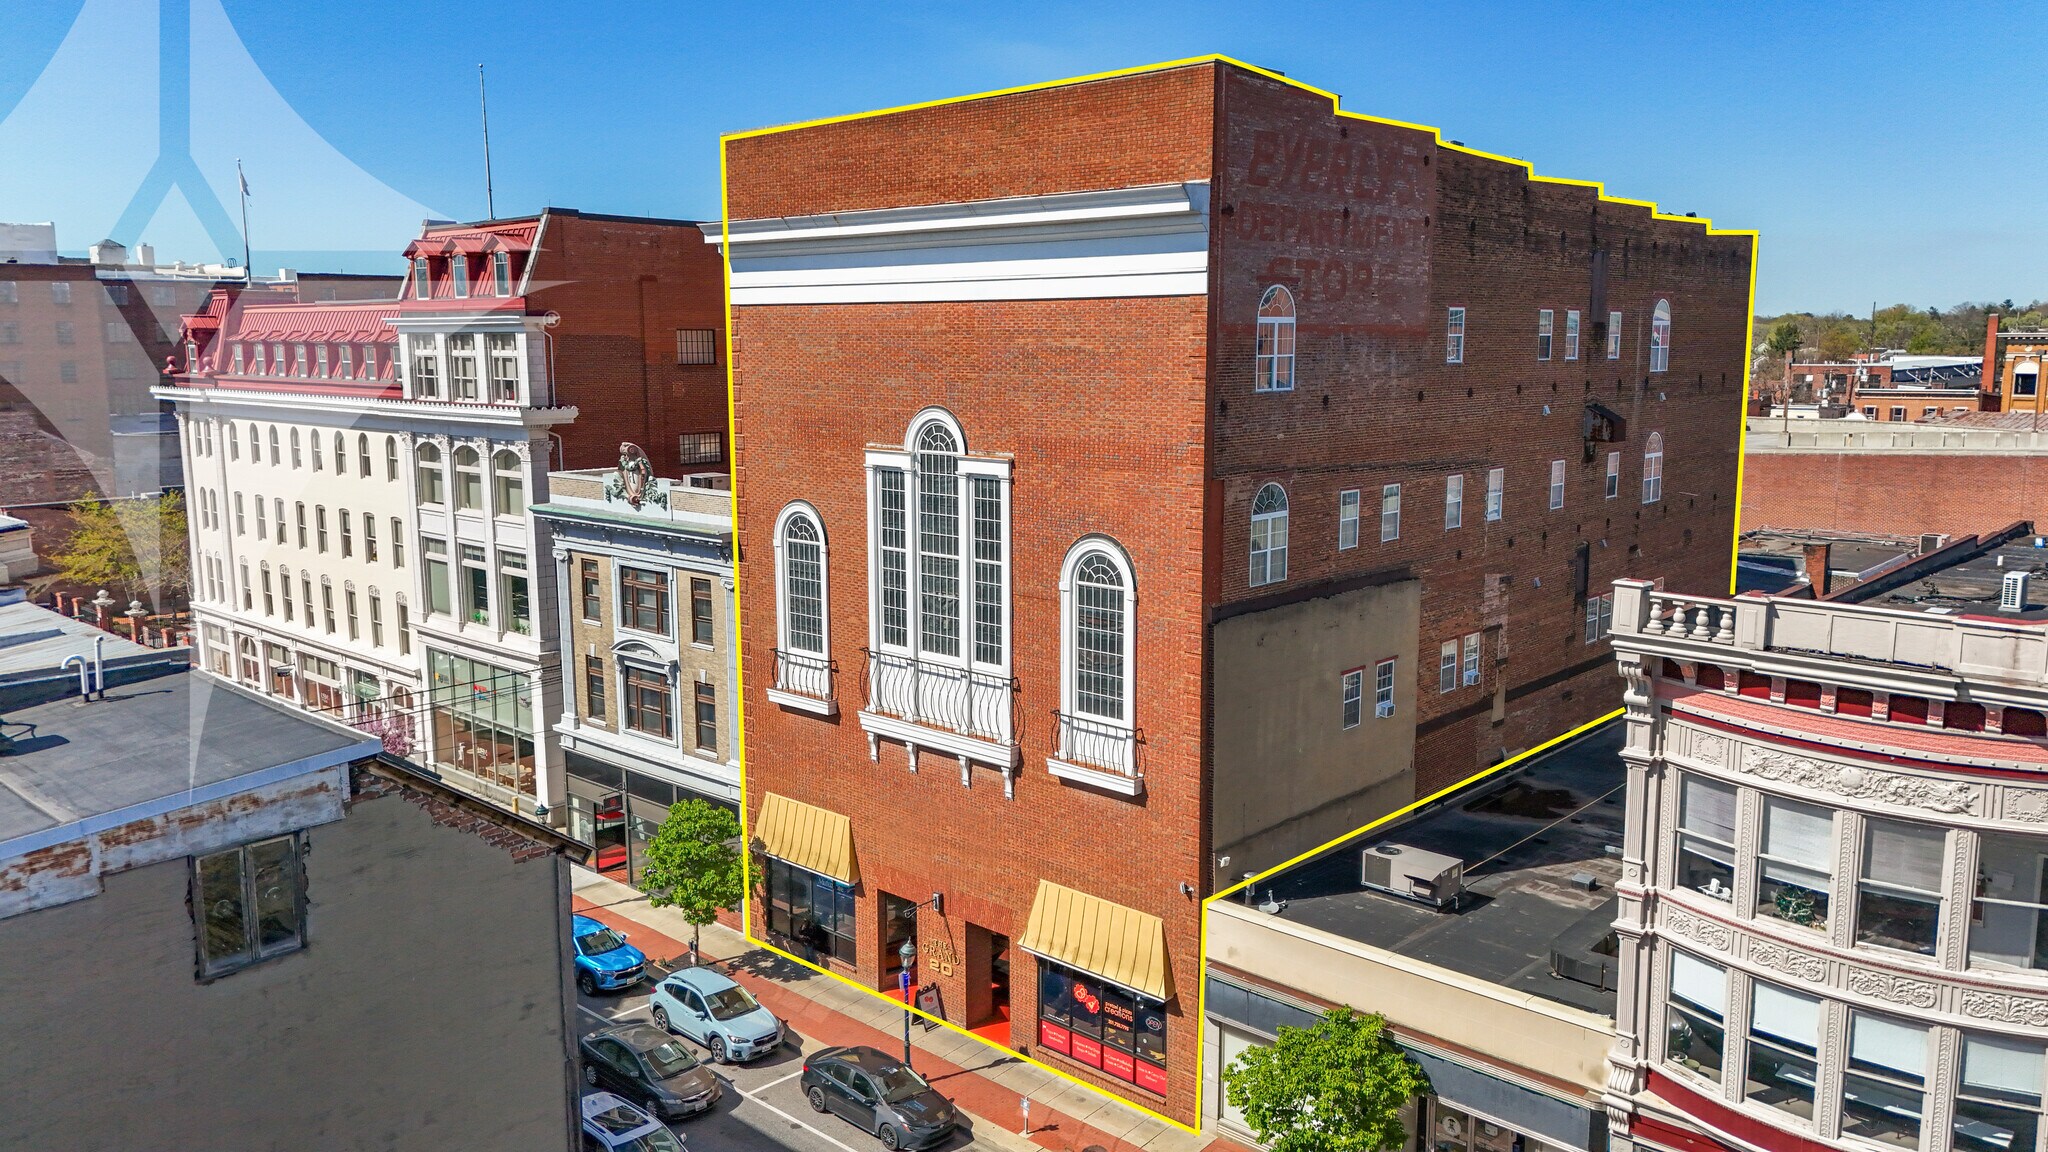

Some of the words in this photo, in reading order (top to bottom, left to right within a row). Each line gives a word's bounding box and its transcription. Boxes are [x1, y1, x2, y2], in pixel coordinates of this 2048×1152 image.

[932, 939, 948, 950] THE
[922, 943, 960, 965] GRAND
[929, 958, 953, 977] 20
[1104, 1005, 1134, 1023] creations
